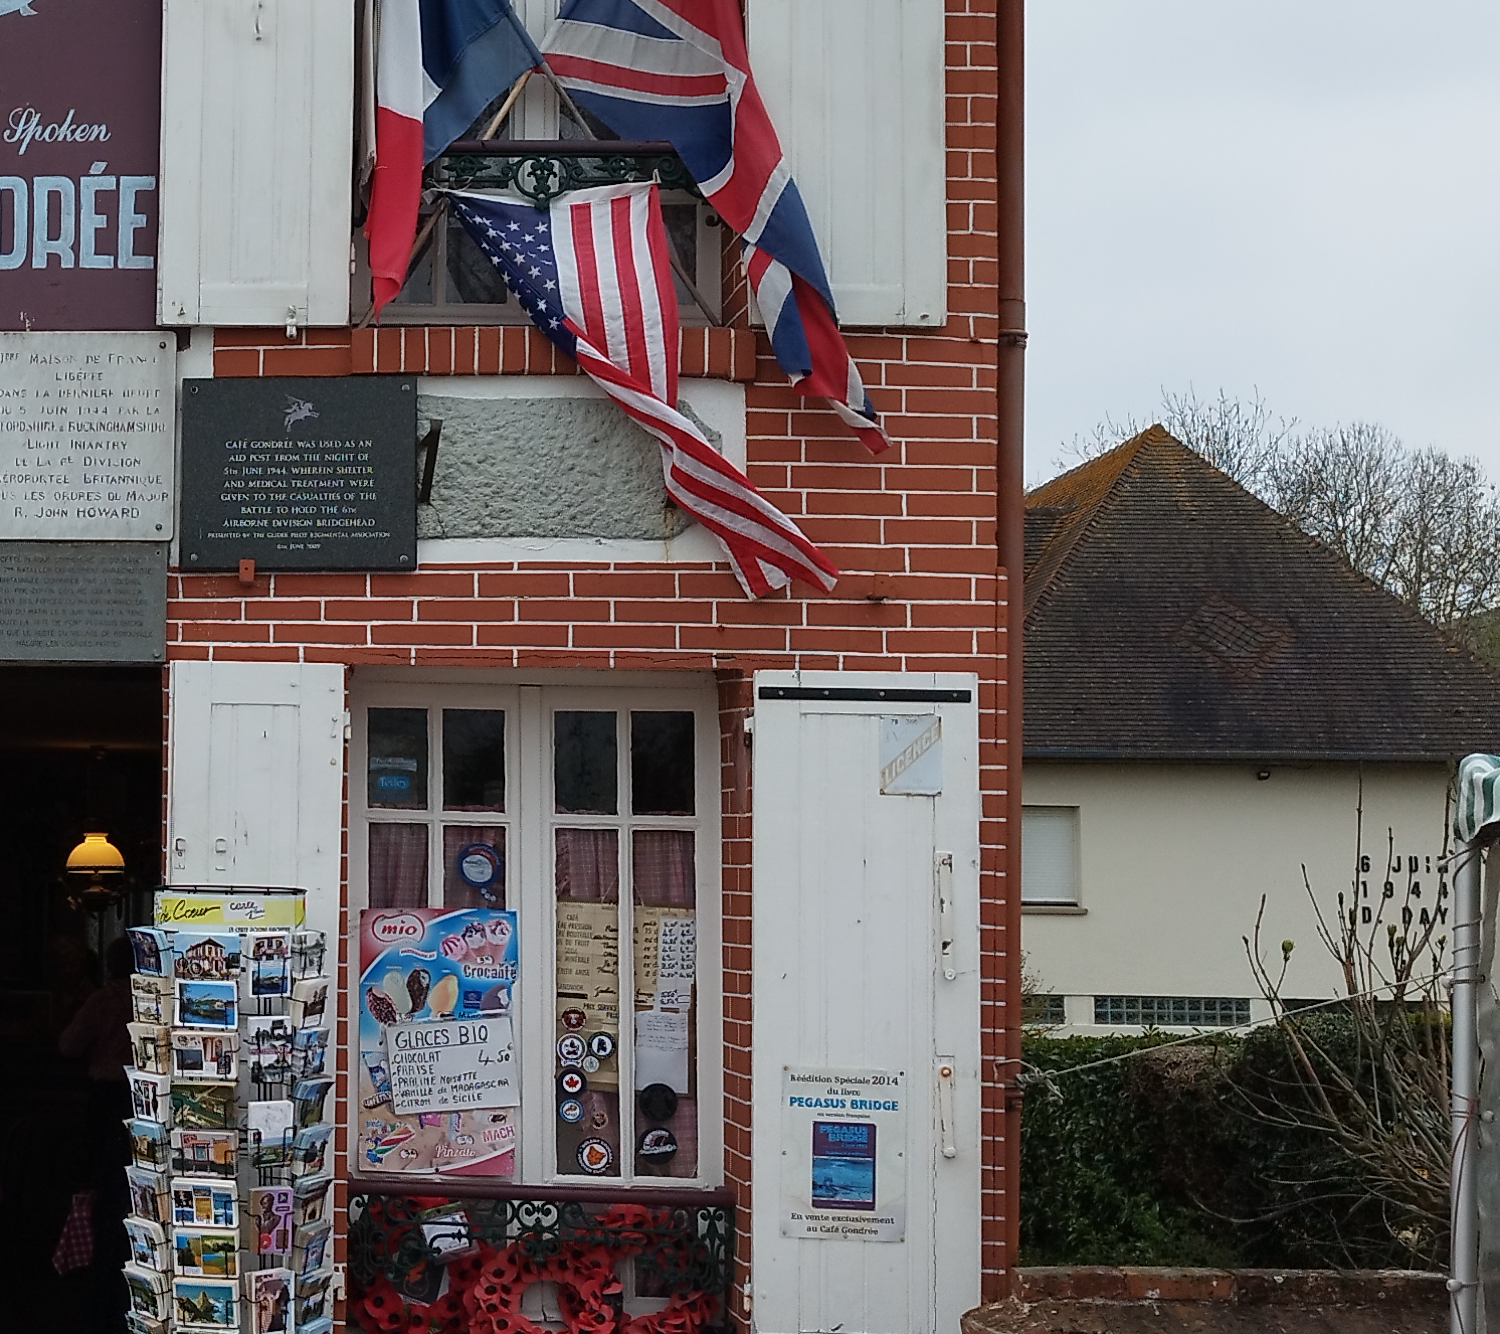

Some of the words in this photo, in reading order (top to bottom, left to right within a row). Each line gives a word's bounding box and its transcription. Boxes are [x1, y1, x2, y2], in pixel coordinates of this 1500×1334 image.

[3, 106, 111, 151] Spoken
[41, 406, 67, 415] JUIN
[225, 438, 247, 449] CAFÉ
[297, 440, 316, 448] WAS
[84, 456, 141, 467] DIVISION
[229, 454, 246, 462] AID
[250, 454, 271, 462] POST
[275, 454, 299, 462] FROM
[325, 453, 354, 461] NIGHT
[242, 467, 263, 476] JUNE
[336, 466, 373, 474] SHELTER
[224, 480, 244, 488] AND
[248, 480, 288, 488] MEDICAL
[349, 479, 374, 487] WERE
[25, 492, 45, 501] LES
[221, 493, 249, 501] GIVEN
[253, 493, 266, 501] TO
[270, 493, 287, 501] THE
[290, 493, 340, 501] CASUALTIES
[360, 493, 377, 501] THE
[34, 507, 68, 518] JOHN
[76, 507, 139, 518] HOWARD
[241, 506, 272, 514] BATTLE
[276, 506, 289, 514] TO
[291, 506, 317, 514] HOLD
[223, 518, 269, 527] AIRBORNE
[272, 519, 313, 527] DIVISION
[316, 519, 375, 527] BRIDGEHEAD
[1361, 855, 1370, 873] 6
[1361, 881, 1448, 899] 1944
[1402, 906, 1448, 925] DAY
[381, 919, 418, 936] mio
[395, 1029, 449, 1049] GLACES
[790, 1074, 832, 1083] Réédition
[834, 1076, 870, 1085] Spéciale
[872, 1076, 899, 1086] 2014
[827, 1087, 839, 1095] du
[841, 1088, 860, 1096] livre
[789, 1097, 846, 1108] PEGASUS
[482, 1126, 515, 1143] MACH
[819, 1124, 867, 1134] PEGASUS
[791, 1212, 803, 1220] En
[805, 1213, 830, 1221] vente
[831, 1215, 895, 1224] exclusivement
[820, 1225, 839, 1233] Café
[841, 1226, 878, 1235] Gondrée
